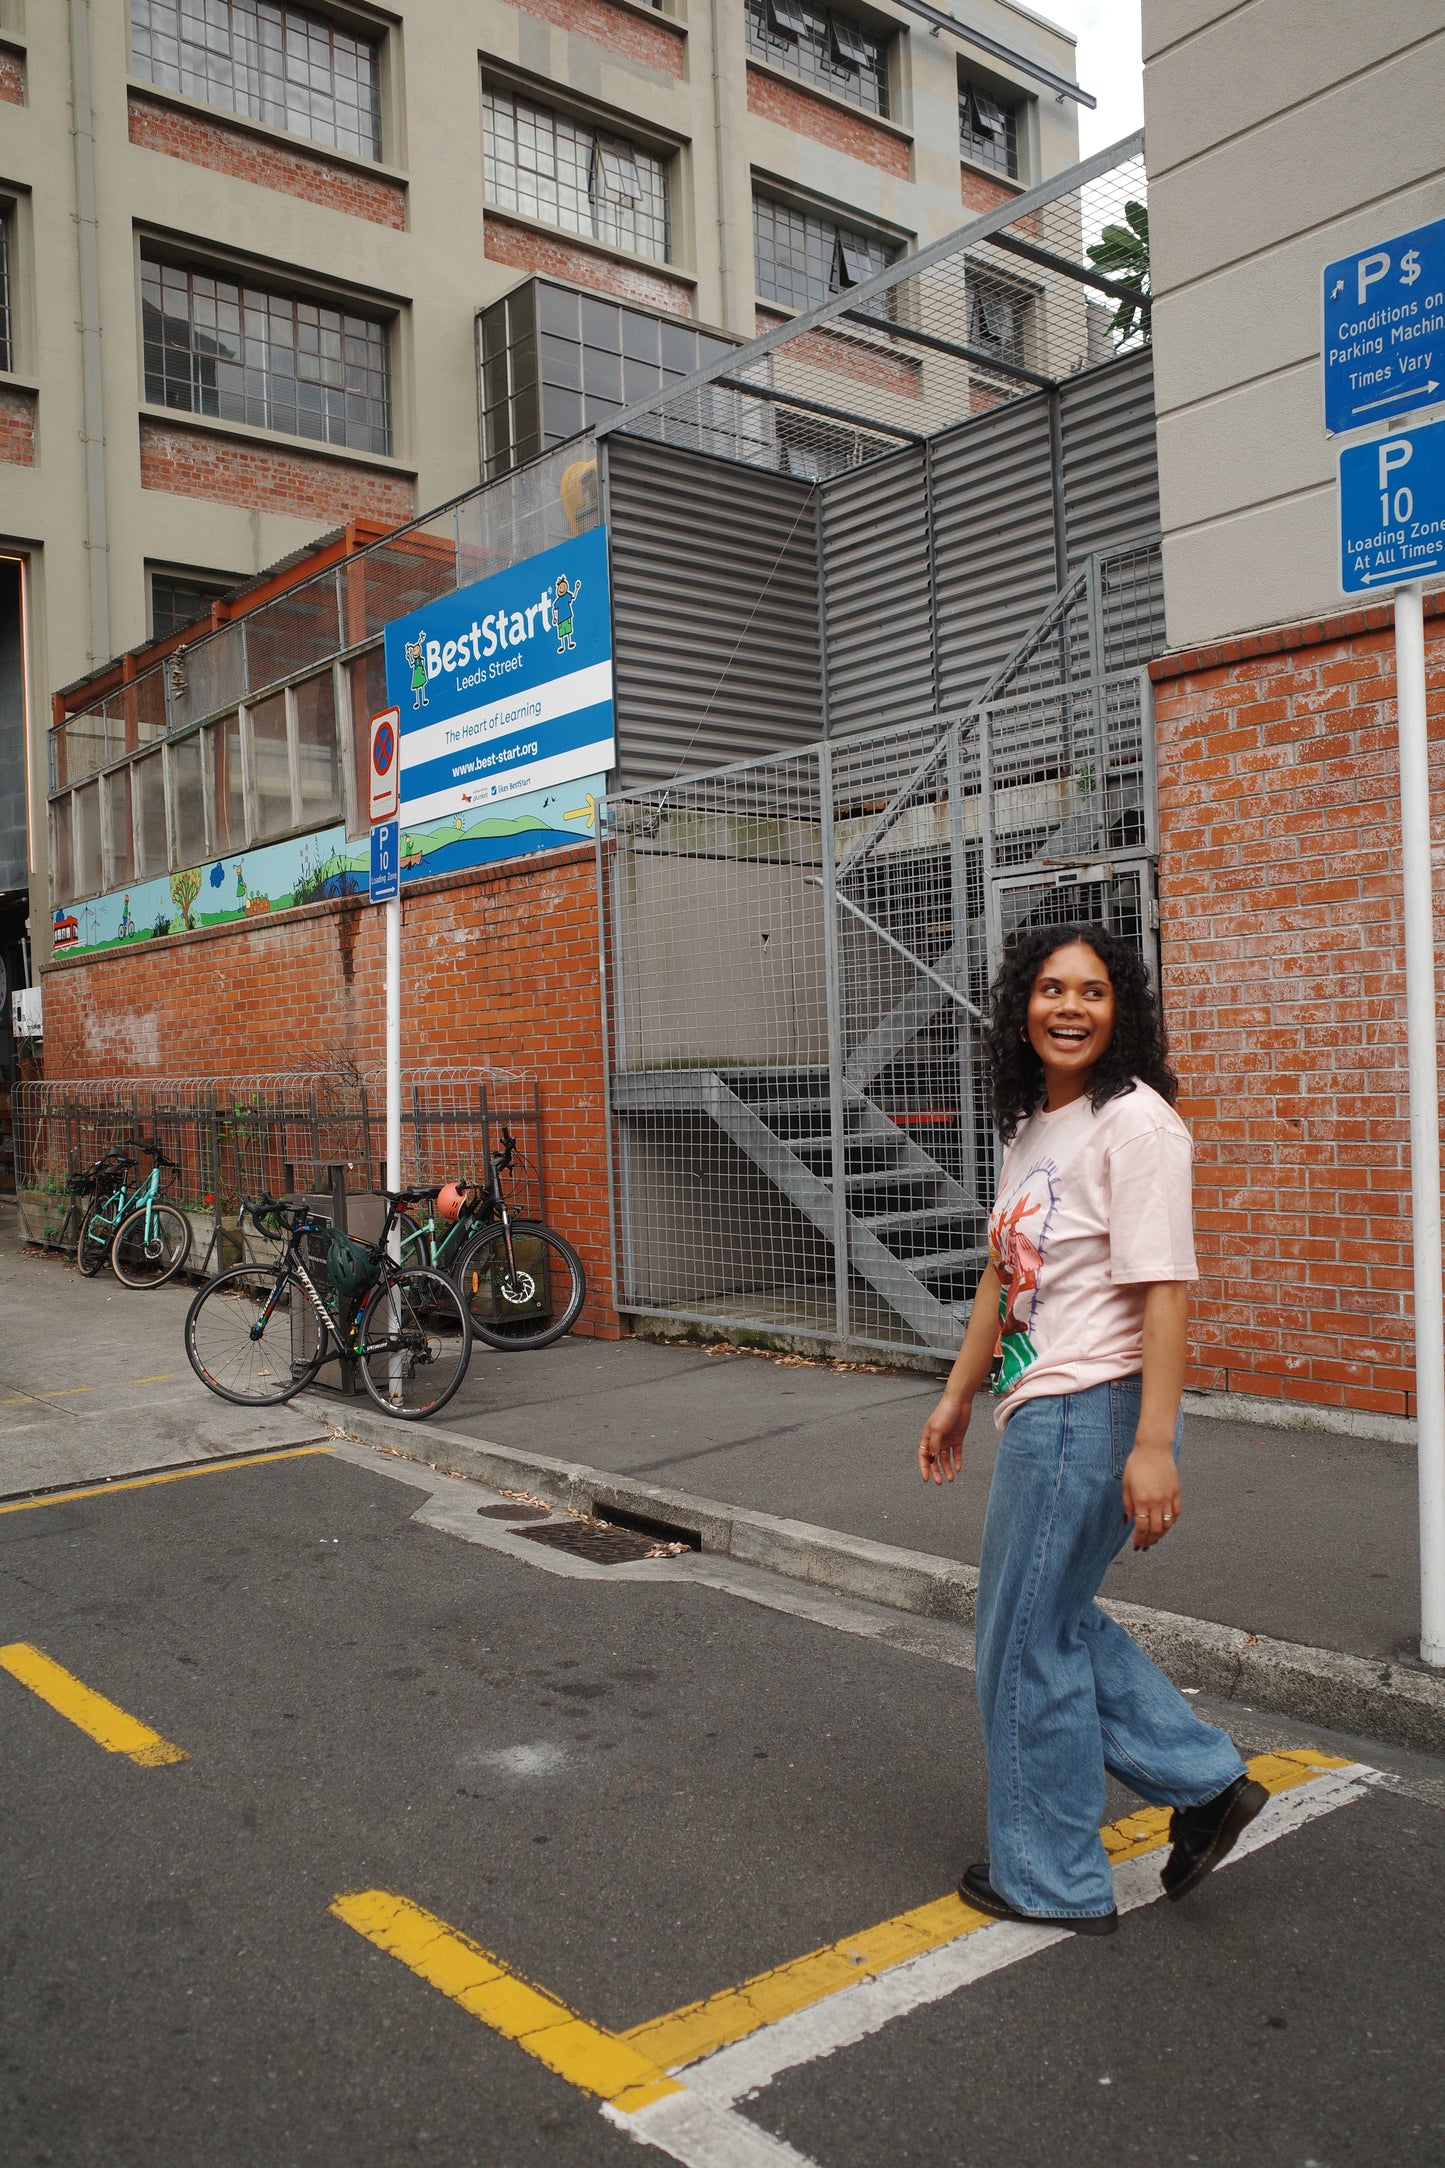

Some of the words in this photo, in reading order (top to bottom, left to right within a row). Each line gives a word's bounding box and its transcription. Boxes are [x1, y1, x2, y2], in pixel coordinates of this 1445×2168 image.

[1358, 252, 1391, 305] P
[1399, 249, 1421, 286] $
[1338, 301, 1418, 340] Conditions
[1425, 292, 1444, 310] on
[1329, 337, 1383, 366] Parking
[1349, 366, 1392, 390] Times
[1399, 352, 1433, 374] Vary
[1378, 439, 1414, 490] P
[1380, 487, 1414, 527] 10
[1347, 529, 1405, 554] Loading
[1410, 519, 1445, 538] Zone
[1354, 555, 1371, 571] At
[1375, 548, 1396, 567] All
[1400, 540, 1444, 560] Times
[425, 591, 552, 680] BestStart
[455, 667, 487, 692] Leeds
[488, 653, 524, 679] Street
[445, 730, 461, 744] The
[462, 721, 488, 739] Heart
[489, 713, 499, 729] of
[500, 701, 542, 725] Learning
[452, 740, 539, 778] www.best-start.org
[379, 826, 389, 851] P
[379, 851, 389, 871] 10
